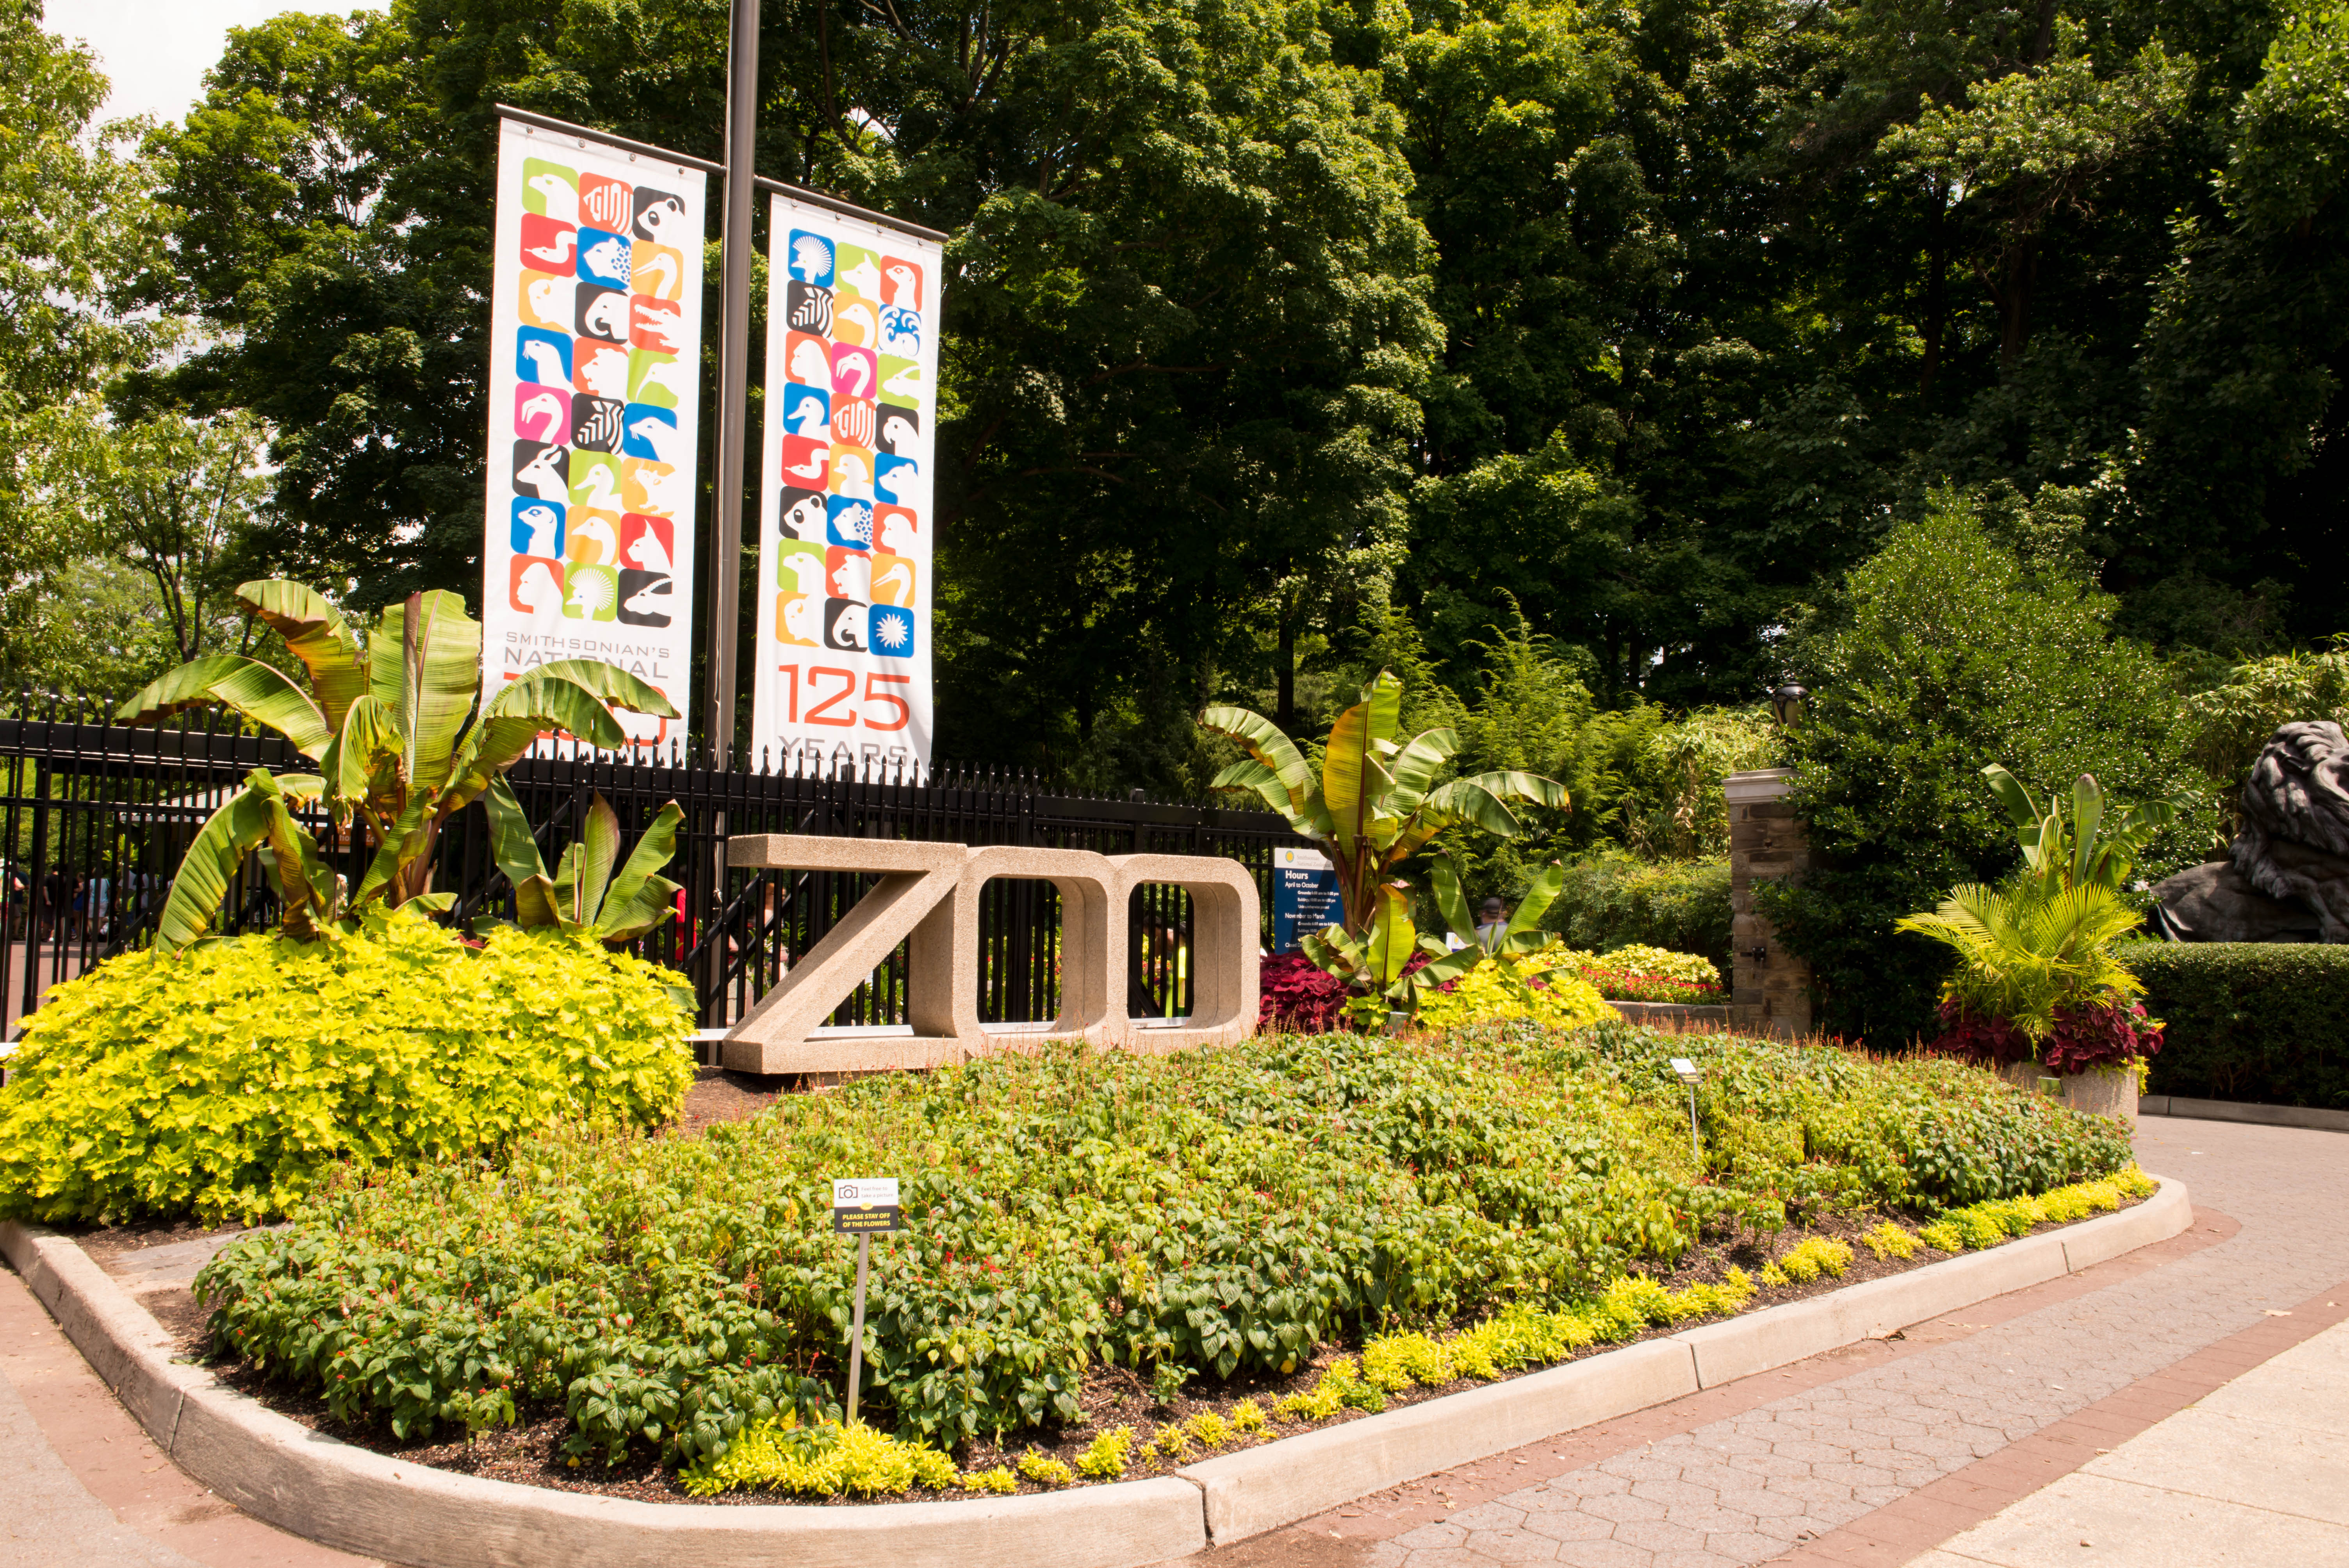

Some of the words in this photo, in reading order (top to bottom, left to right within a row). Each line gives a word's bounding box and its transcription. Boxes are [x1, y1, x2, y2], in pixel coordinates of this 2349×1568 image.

[506, 631, 669, 658] SMITHSONIAN'S
[779, 664, 910, 731] 125
[778, 735, 908, 767] YEARS
[1285, 870, 1308, 879] Hours
[722, 834, 1261, 1074] ZOO
